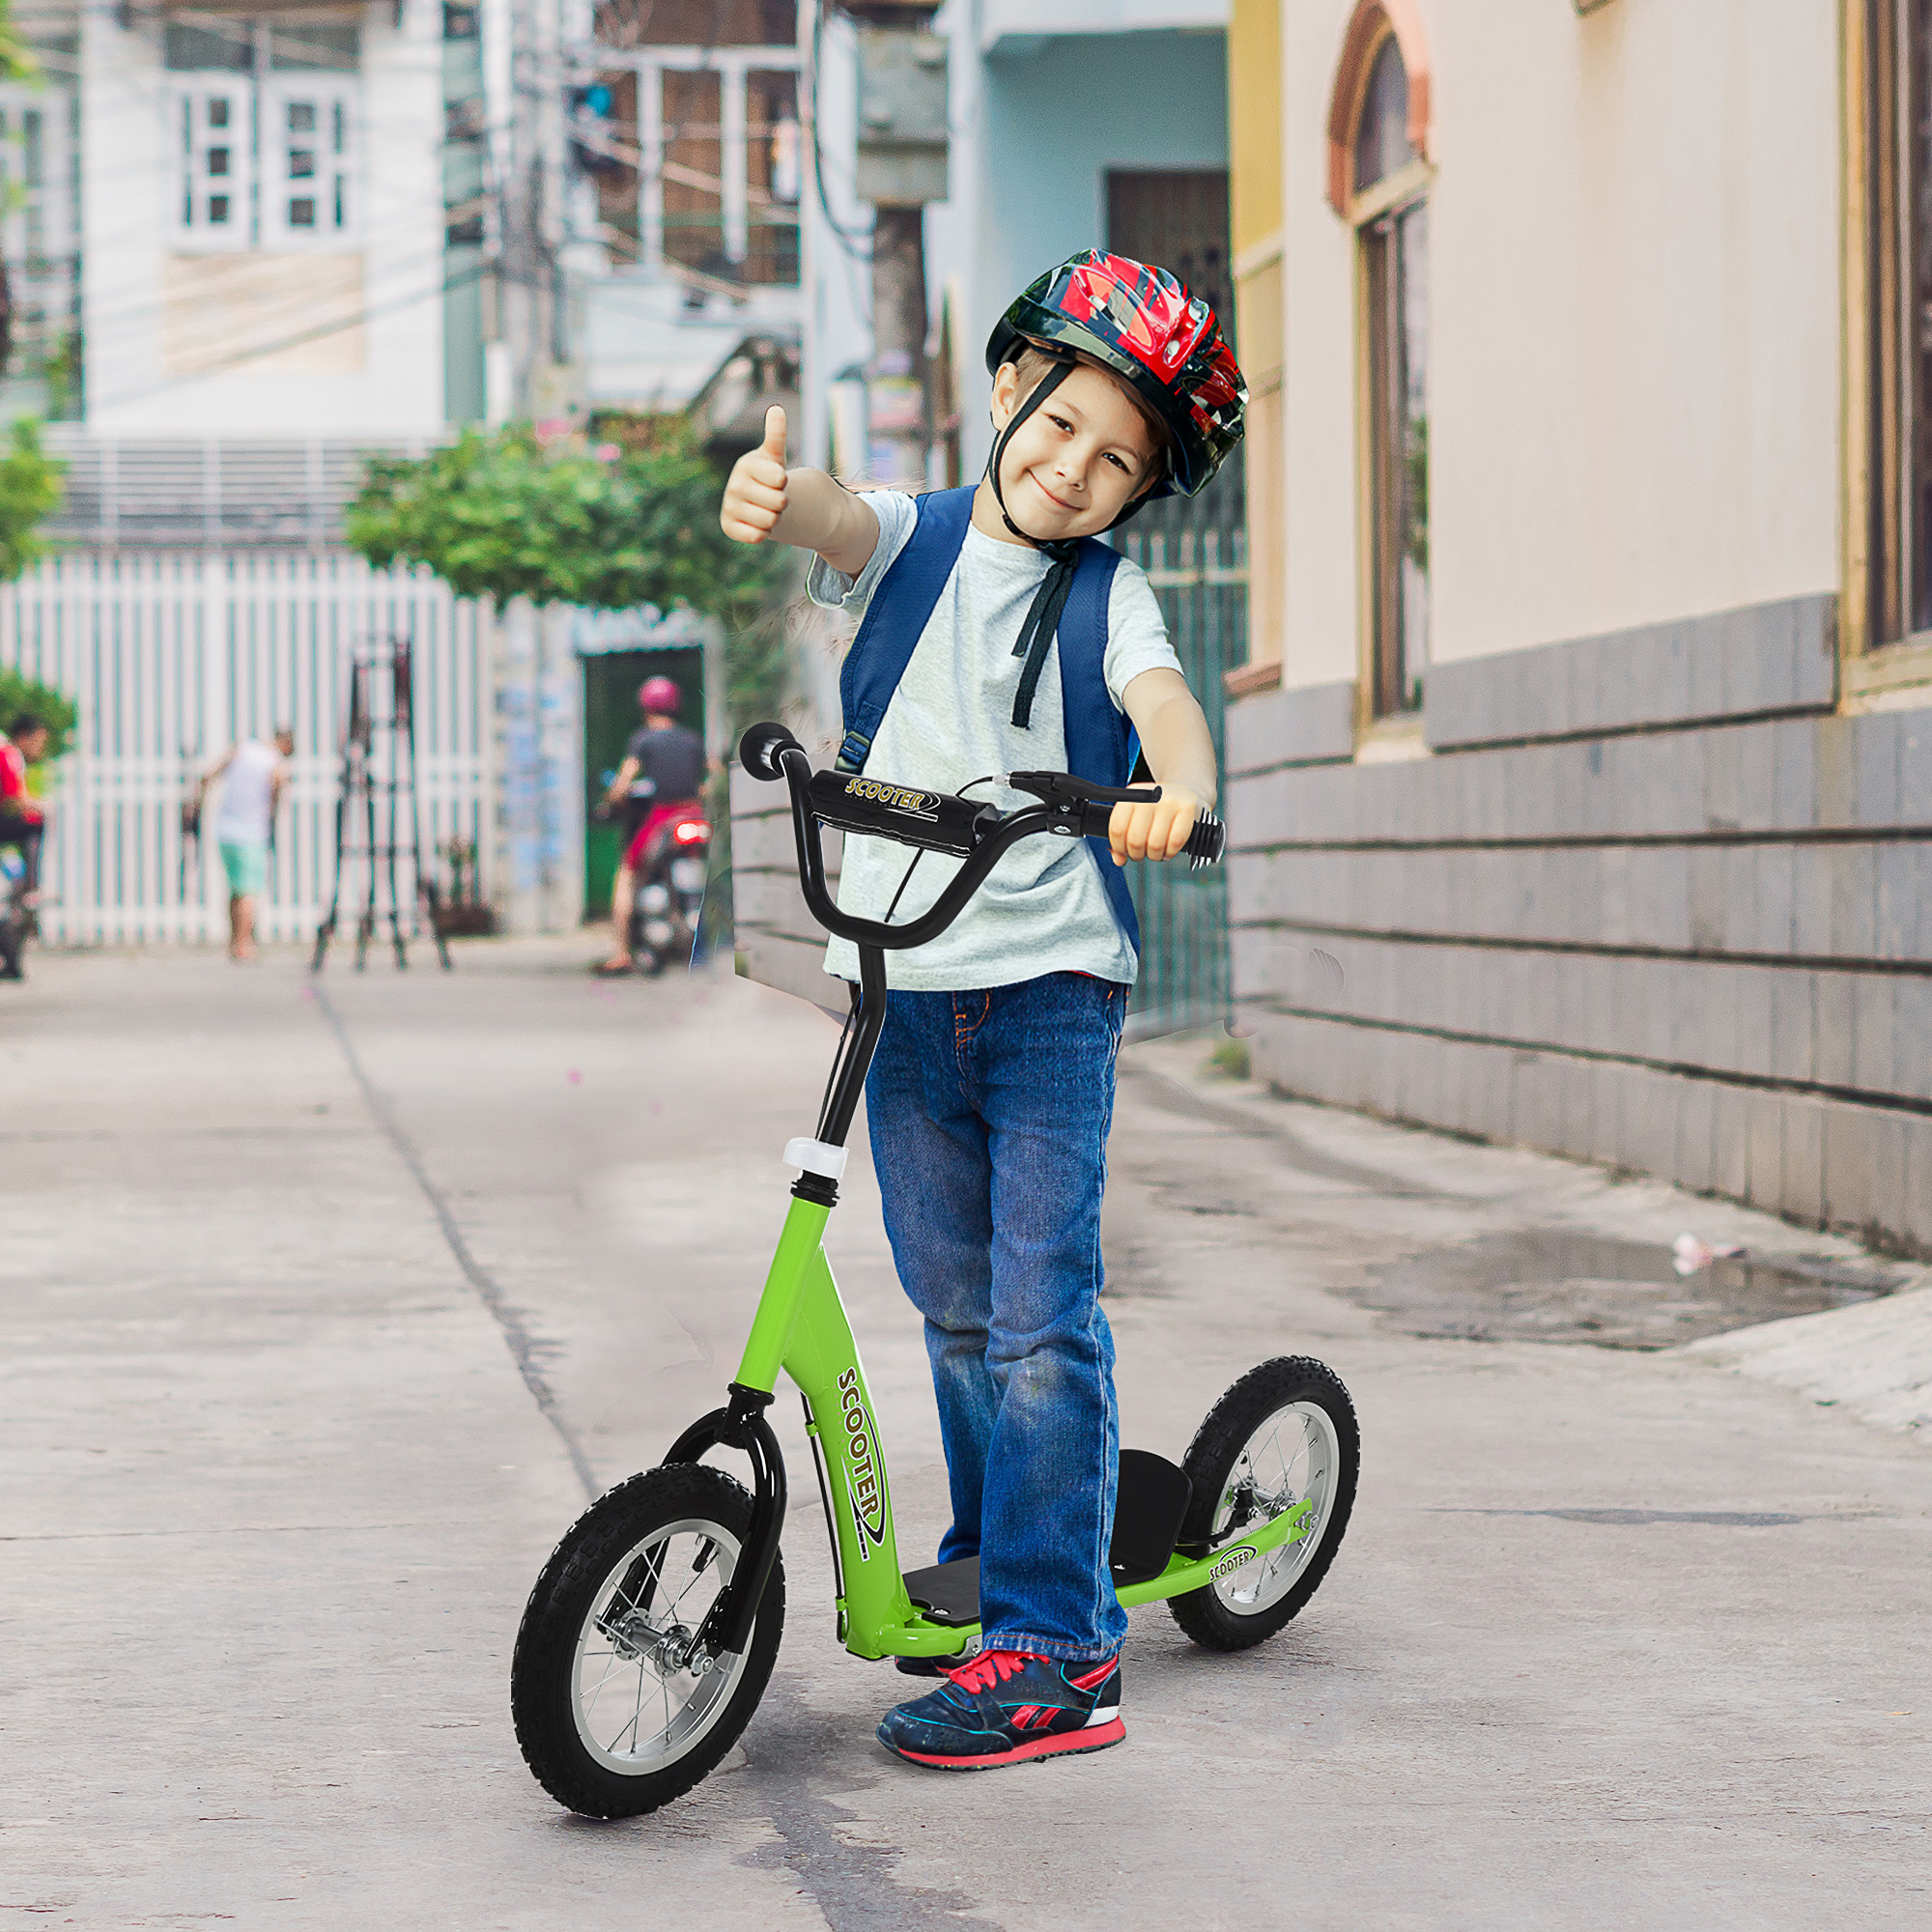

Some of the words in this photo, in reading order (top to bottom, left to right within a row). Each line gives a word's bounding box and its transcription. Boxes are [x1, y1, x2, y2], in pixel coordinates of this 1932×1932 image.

[845, 778, 924, 810] SCOOTER
[838, 1367, 879, 1520] SCOOTER
[1209, 1551, 1250, 1581] SCOOTER
